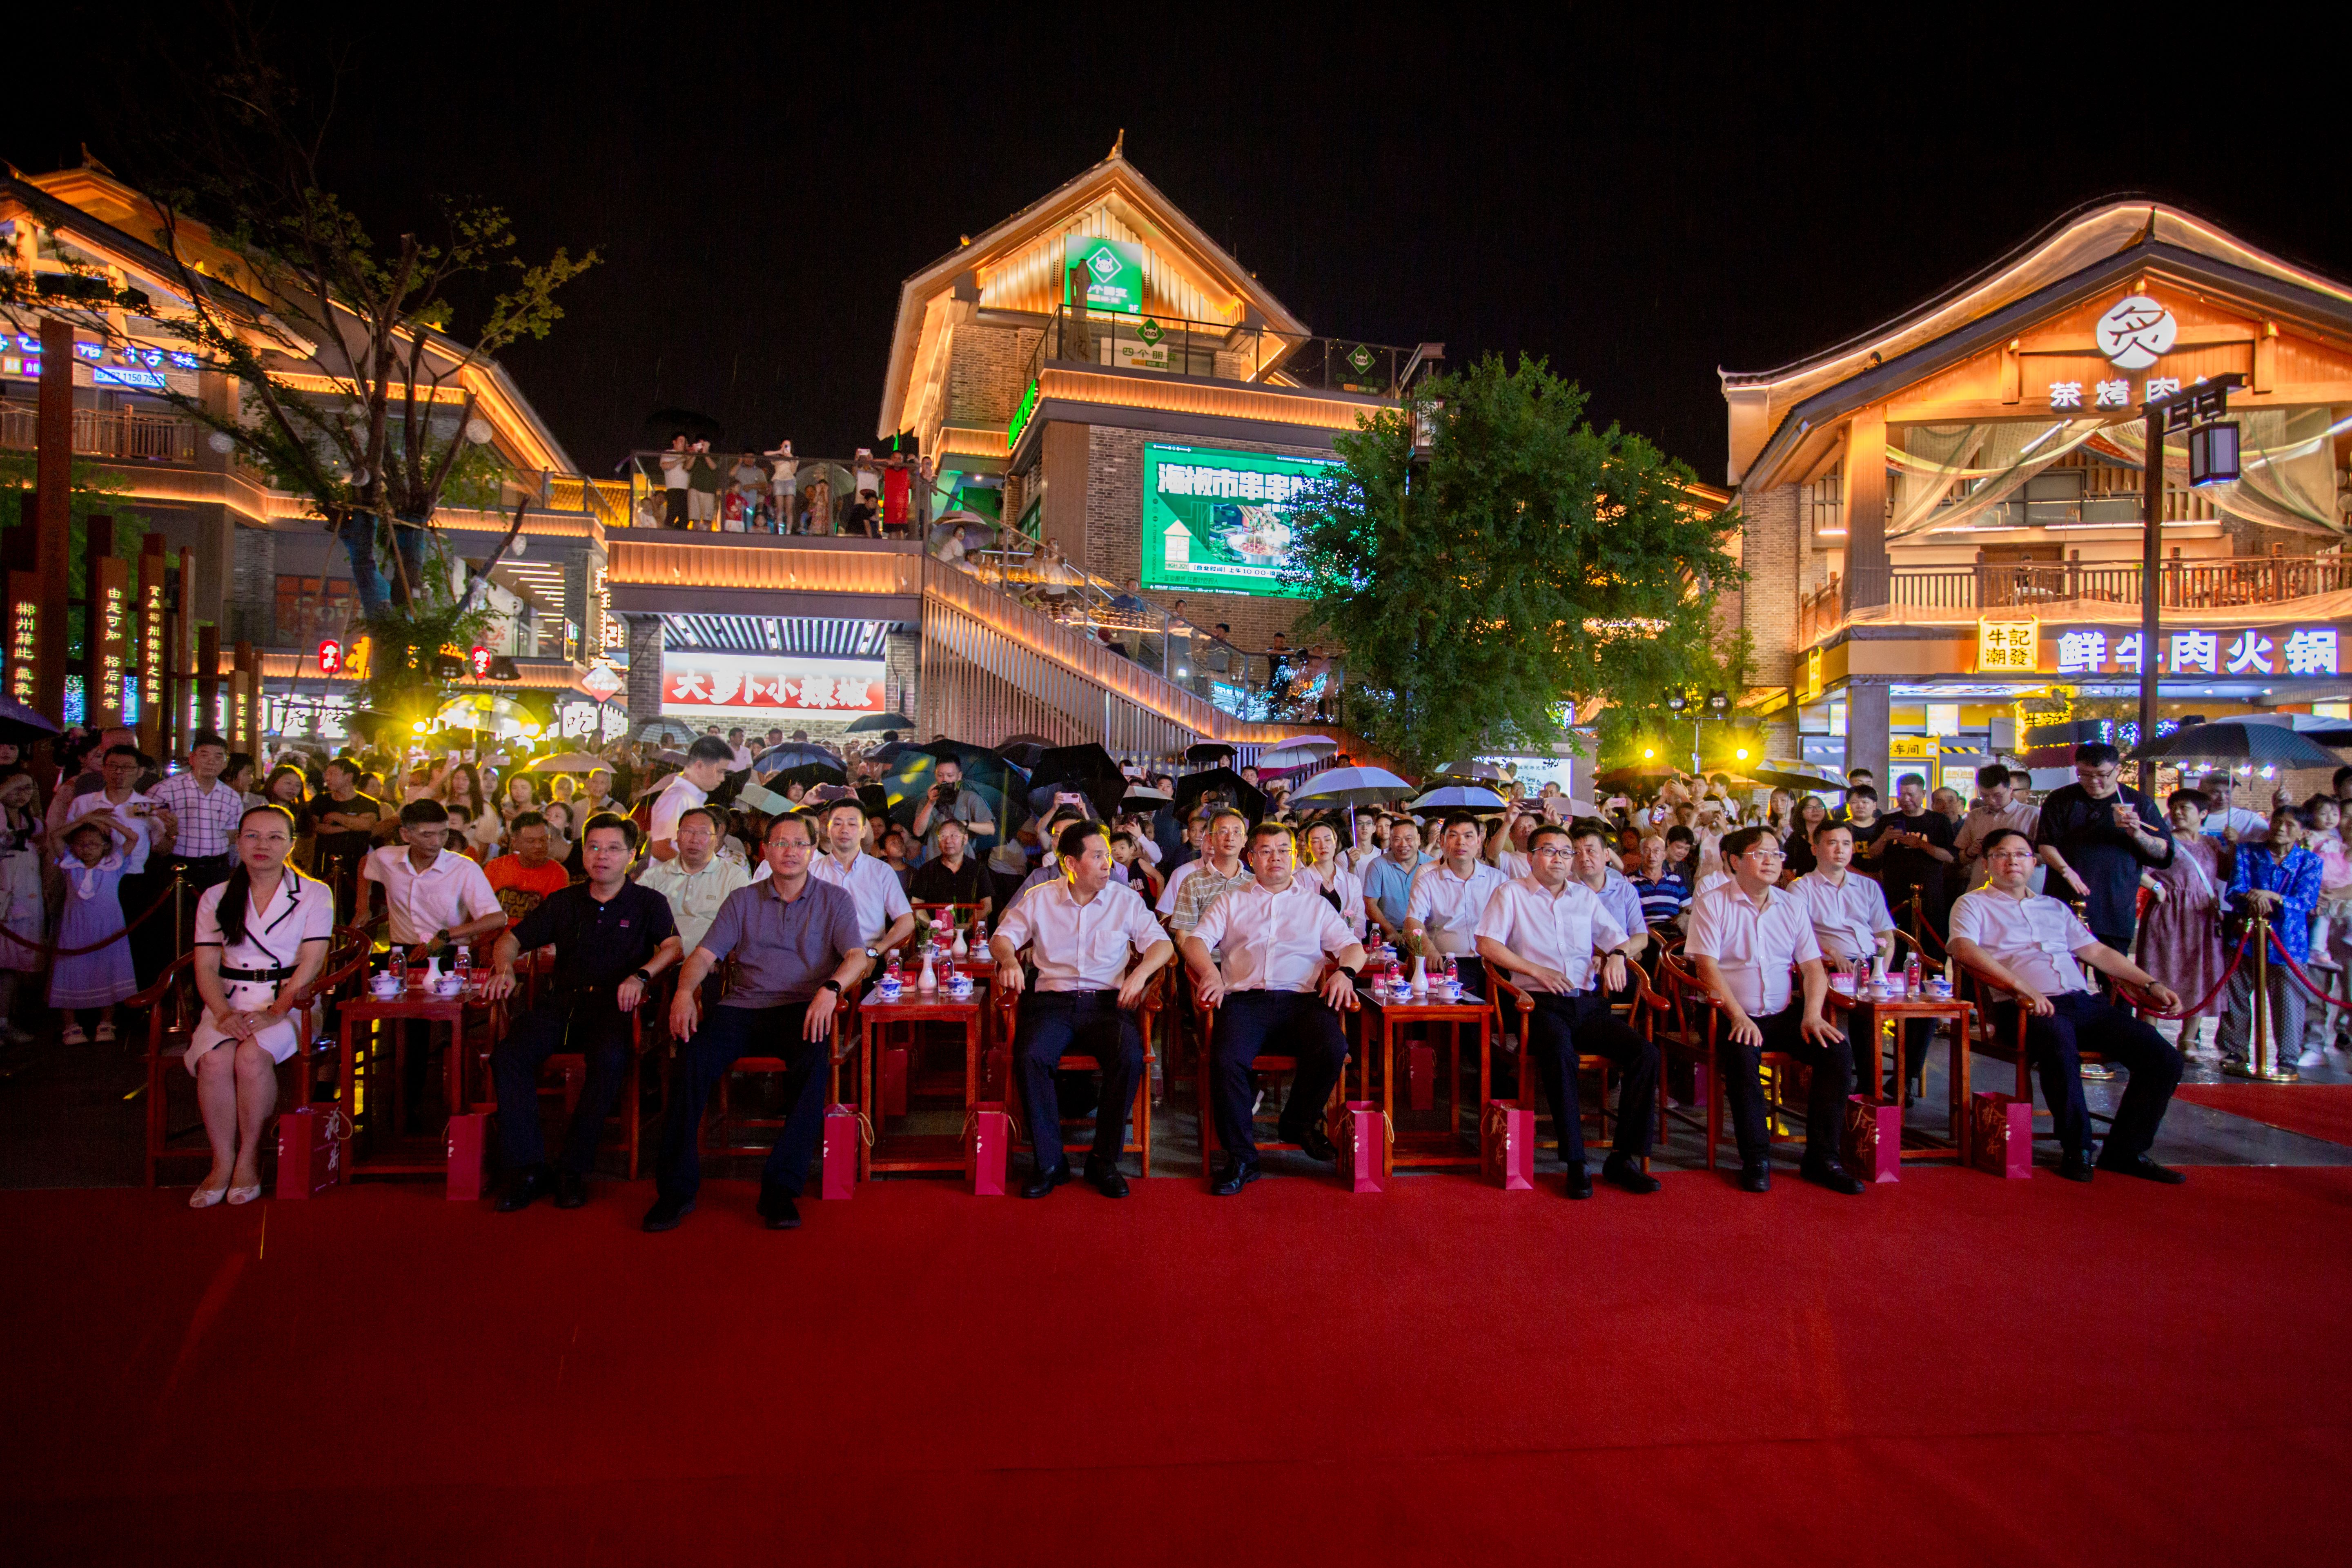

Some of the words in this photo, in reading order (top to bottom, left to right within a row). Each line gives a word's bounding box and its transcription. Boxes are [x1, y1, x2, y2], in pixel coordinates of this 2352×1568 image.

[1128, 304, 1139, 314] 3F
[2108, 305, 2167, 363] 炙
[123, 373, 142, 382] 1150
[2050, 376, 2211, 408] 茶烤肉
[105, 587, 122, 641] 由是可知
[2057, 629, 2339, 675] 鲜牛肉火锅
[672, 668, 873, 709] 大萝卜小辣椒
[566, 710, 593, 734] 吃
